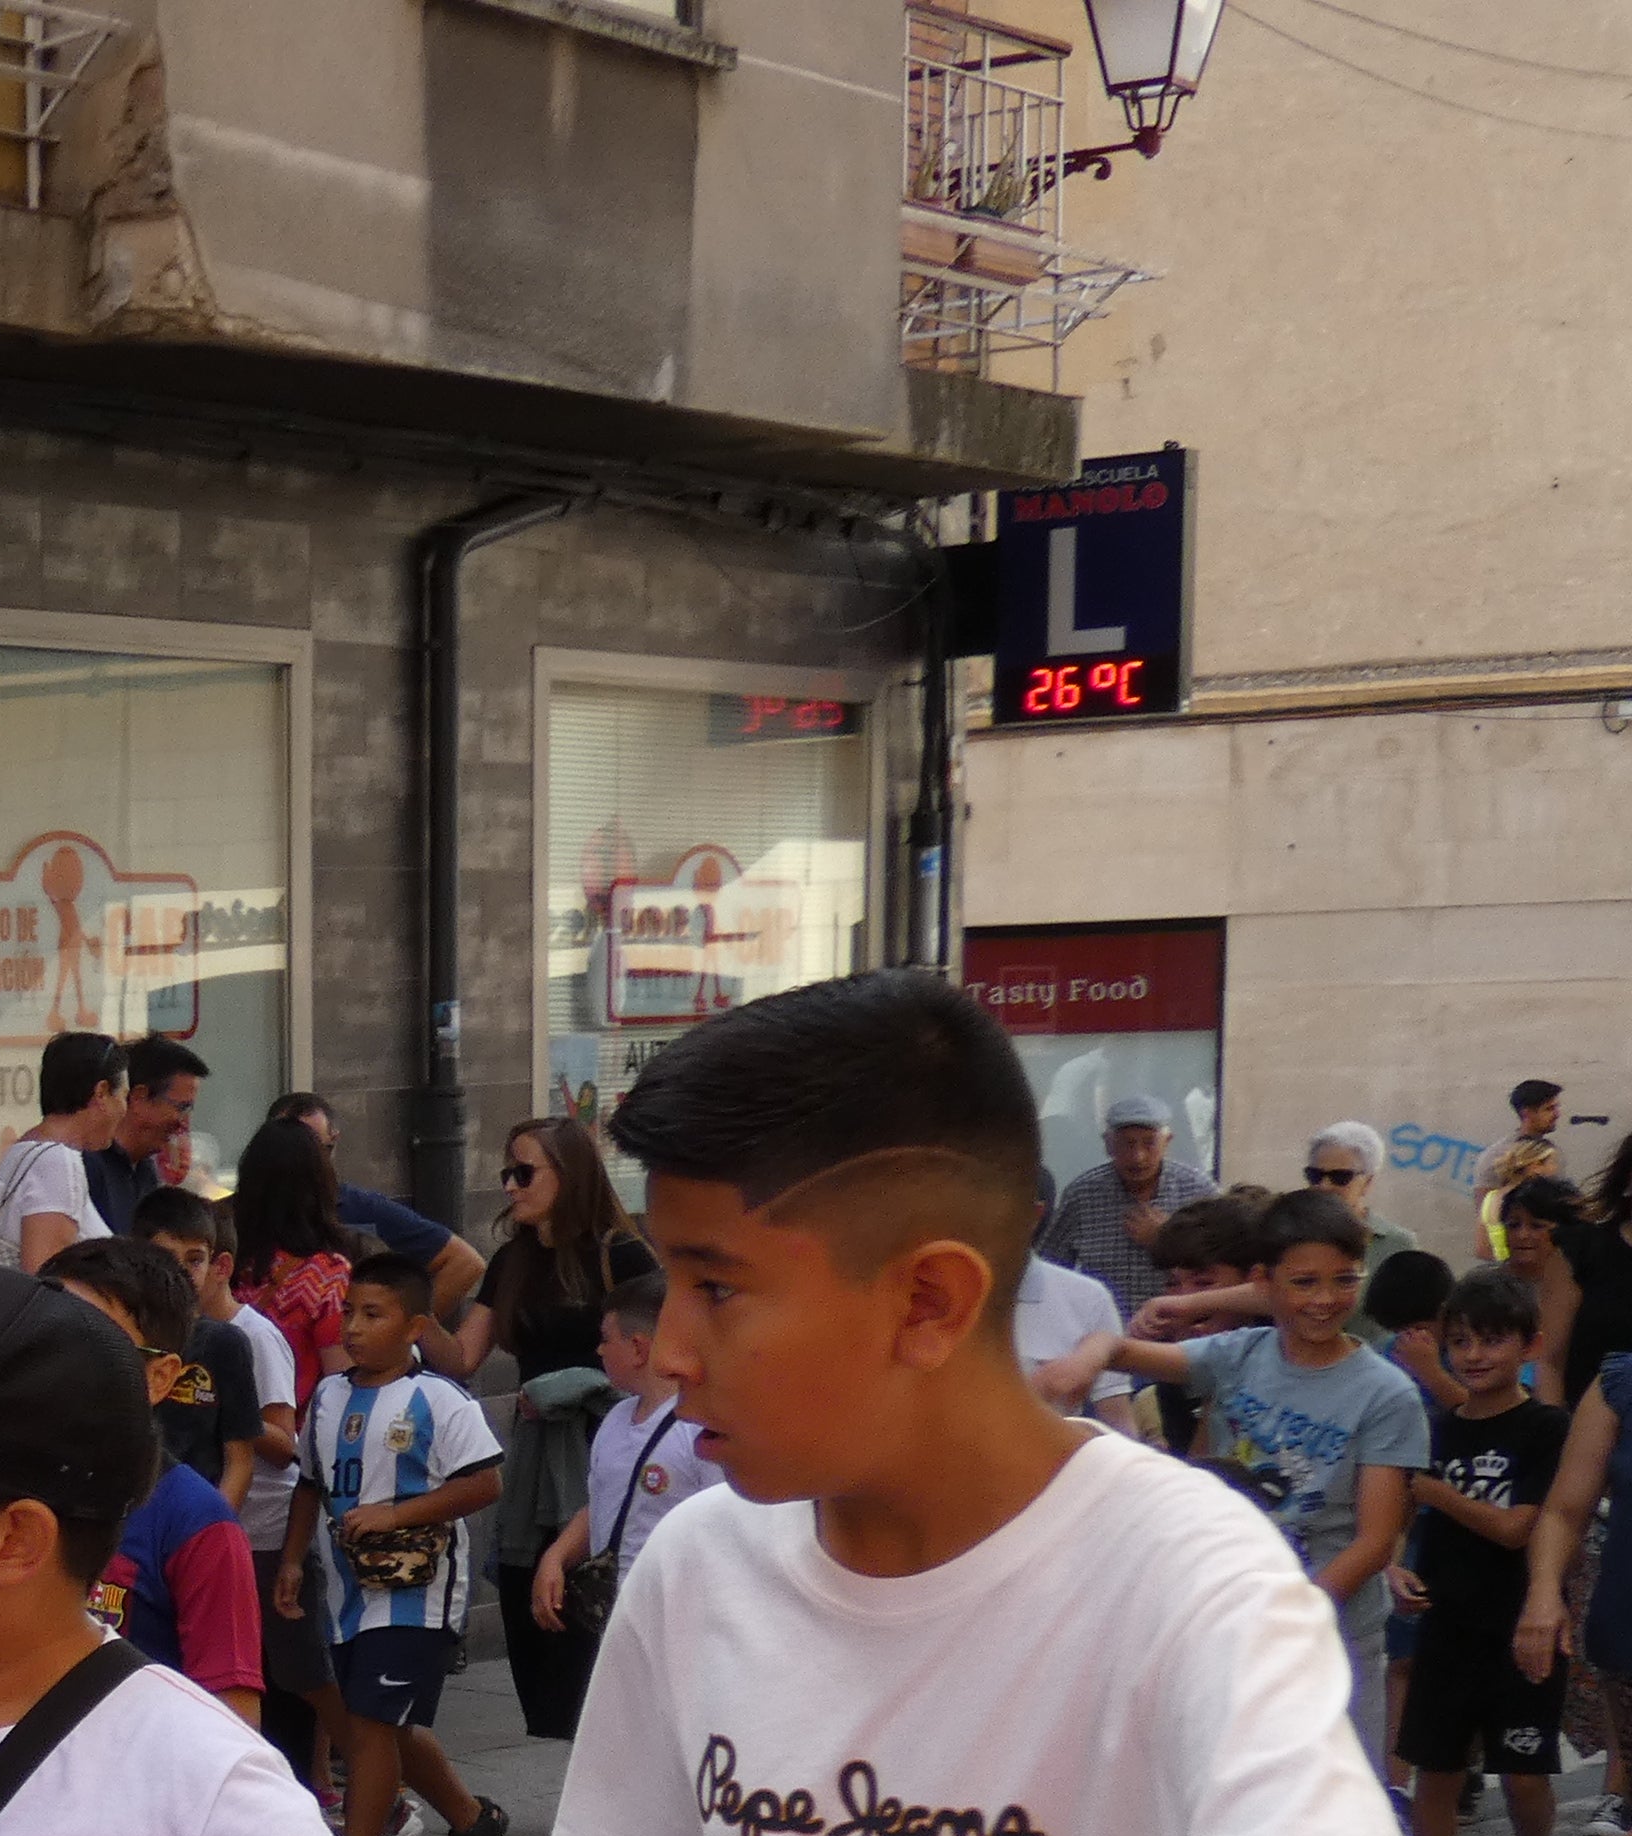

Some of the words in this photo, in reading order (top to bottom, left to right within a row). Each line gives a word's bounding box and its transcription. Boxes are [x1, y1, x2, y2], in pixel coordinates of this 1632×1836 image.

[1013, 481, 1169, 522] MANOLO
[1046, 526, 1127, 658] L
[966, 981, 1056, 1010] Tasty
[1069, 974, 1149, 1002] Food
[330, 1458, 364, 1498] 10
